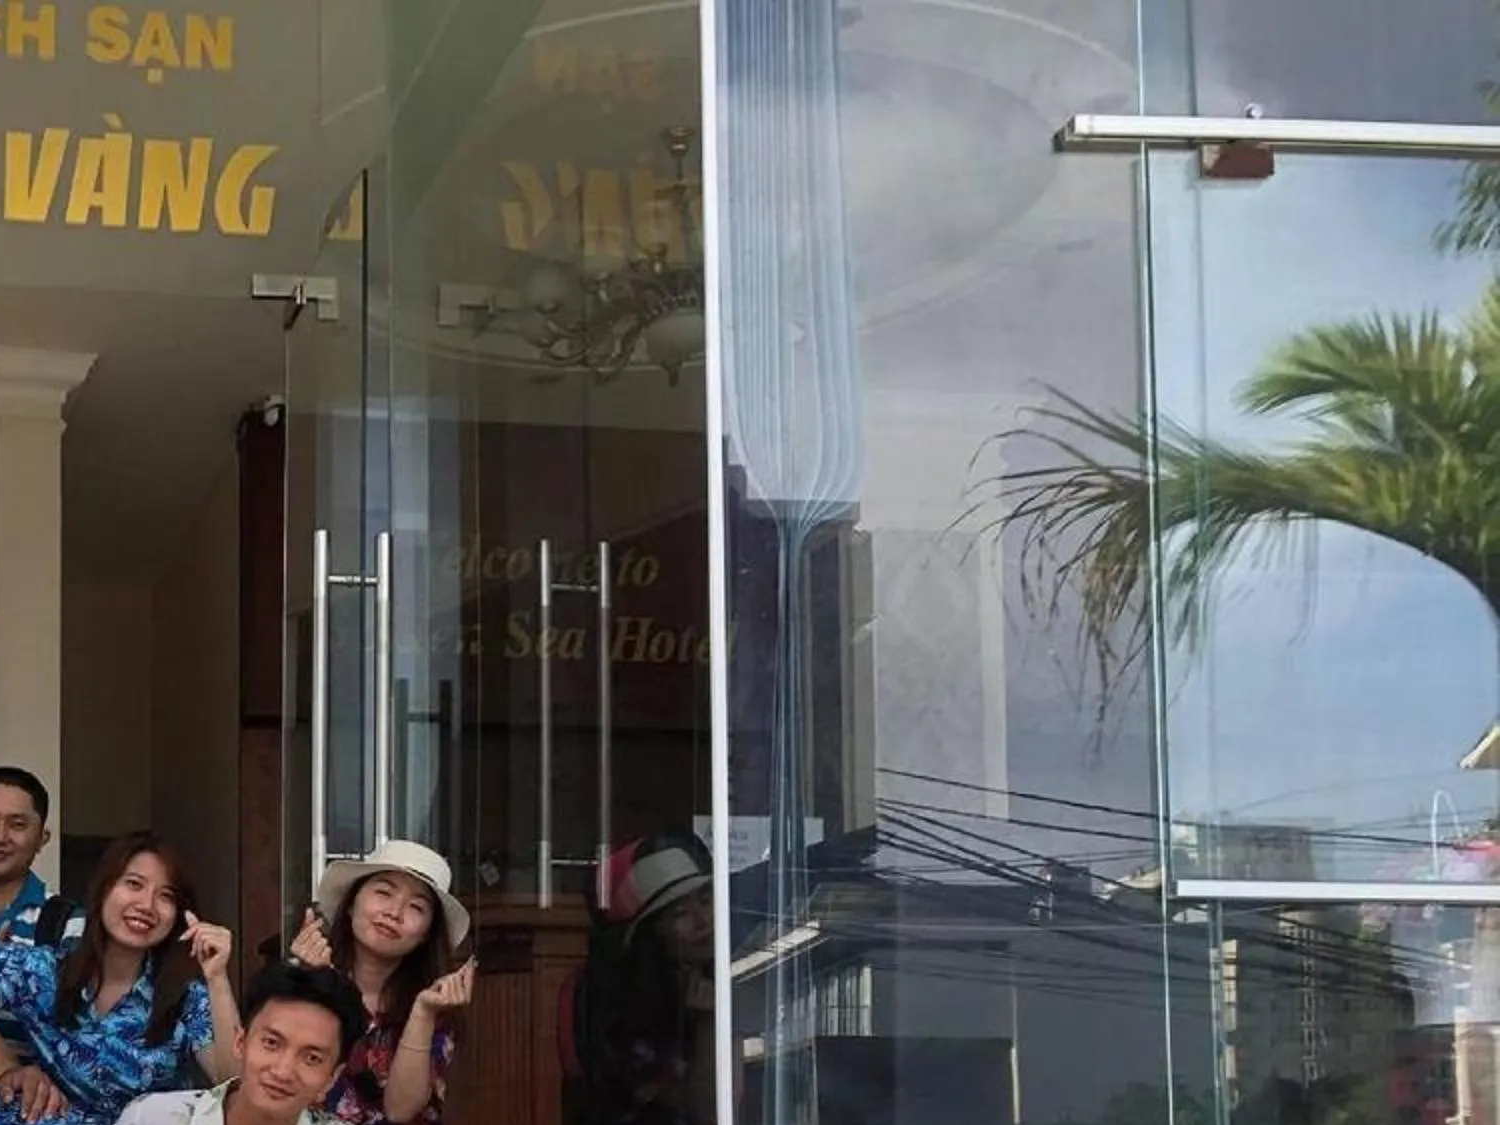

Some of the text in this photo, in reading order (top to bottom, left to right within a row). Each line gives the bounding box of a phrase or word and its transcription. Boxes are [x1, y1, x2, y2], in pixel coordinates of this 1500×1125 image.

[85, 5, 235, 84] SẠN
[3, 112, 280, 237] VÀNG
[615, 545, 661, 588] to
[503, 608, 587, 660] Sea
